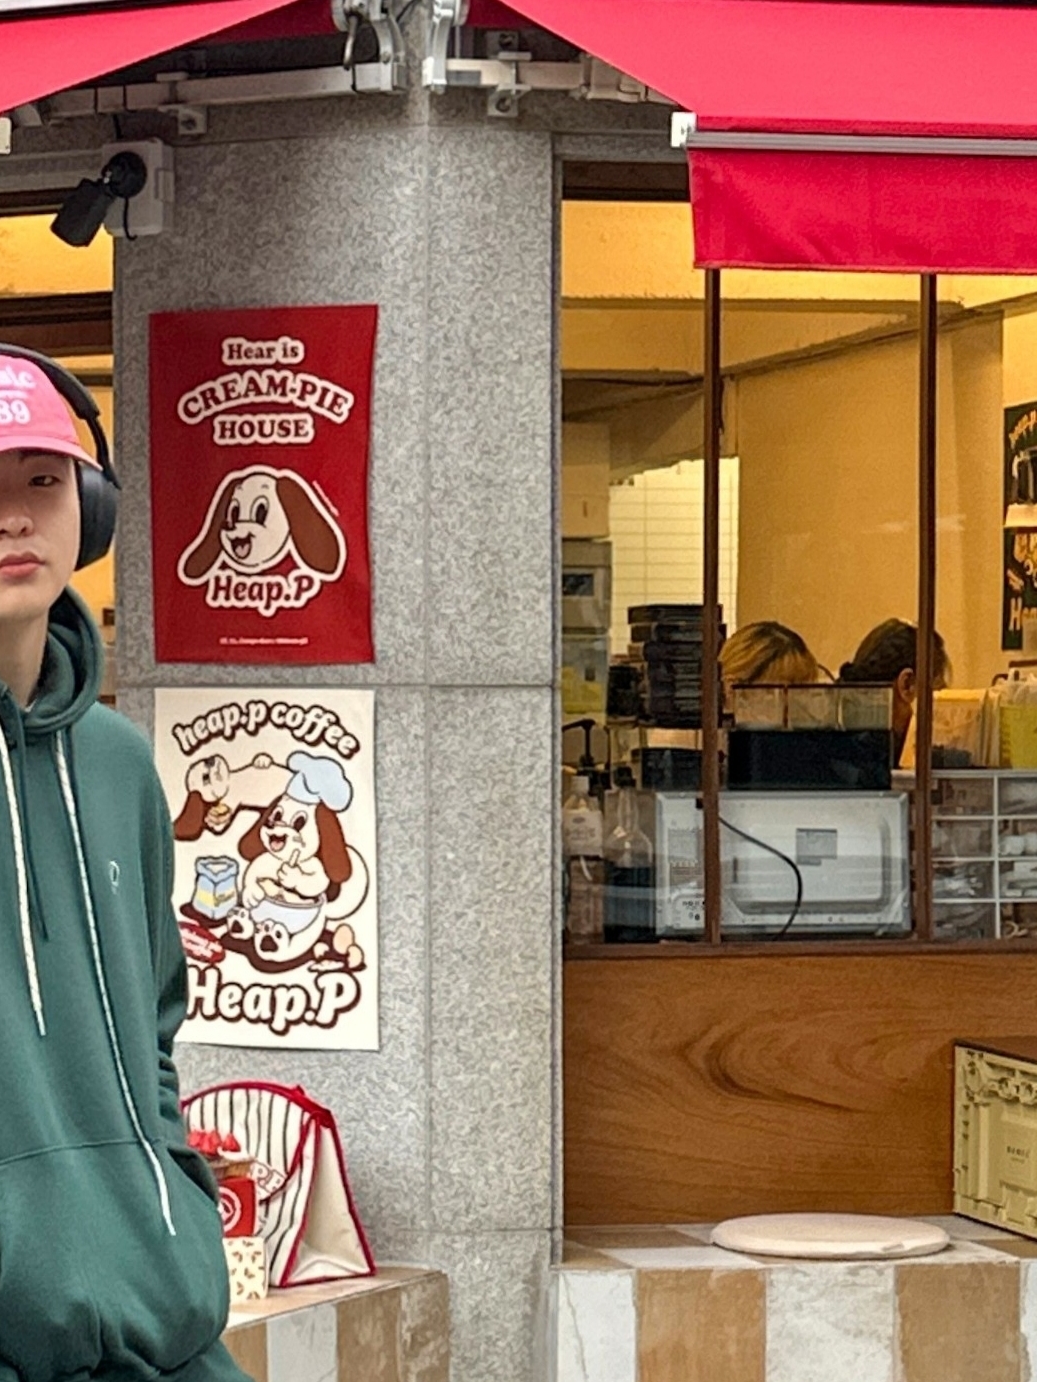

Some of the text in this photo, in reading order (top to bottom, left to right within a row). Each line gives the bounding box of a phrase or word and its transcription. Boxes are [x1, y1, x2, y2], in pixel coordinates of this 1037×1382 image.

[226, 340, 299, 360] Hear is
[181, 374, 349, 419] CREAM-PIE
[217, 418, 310, 440] HOUSE
[211, 574, 315, 611] Heap.P
[172, 700, 361, 760] heap.p coffee
[186, 964, 362, 1036] Heap.P
